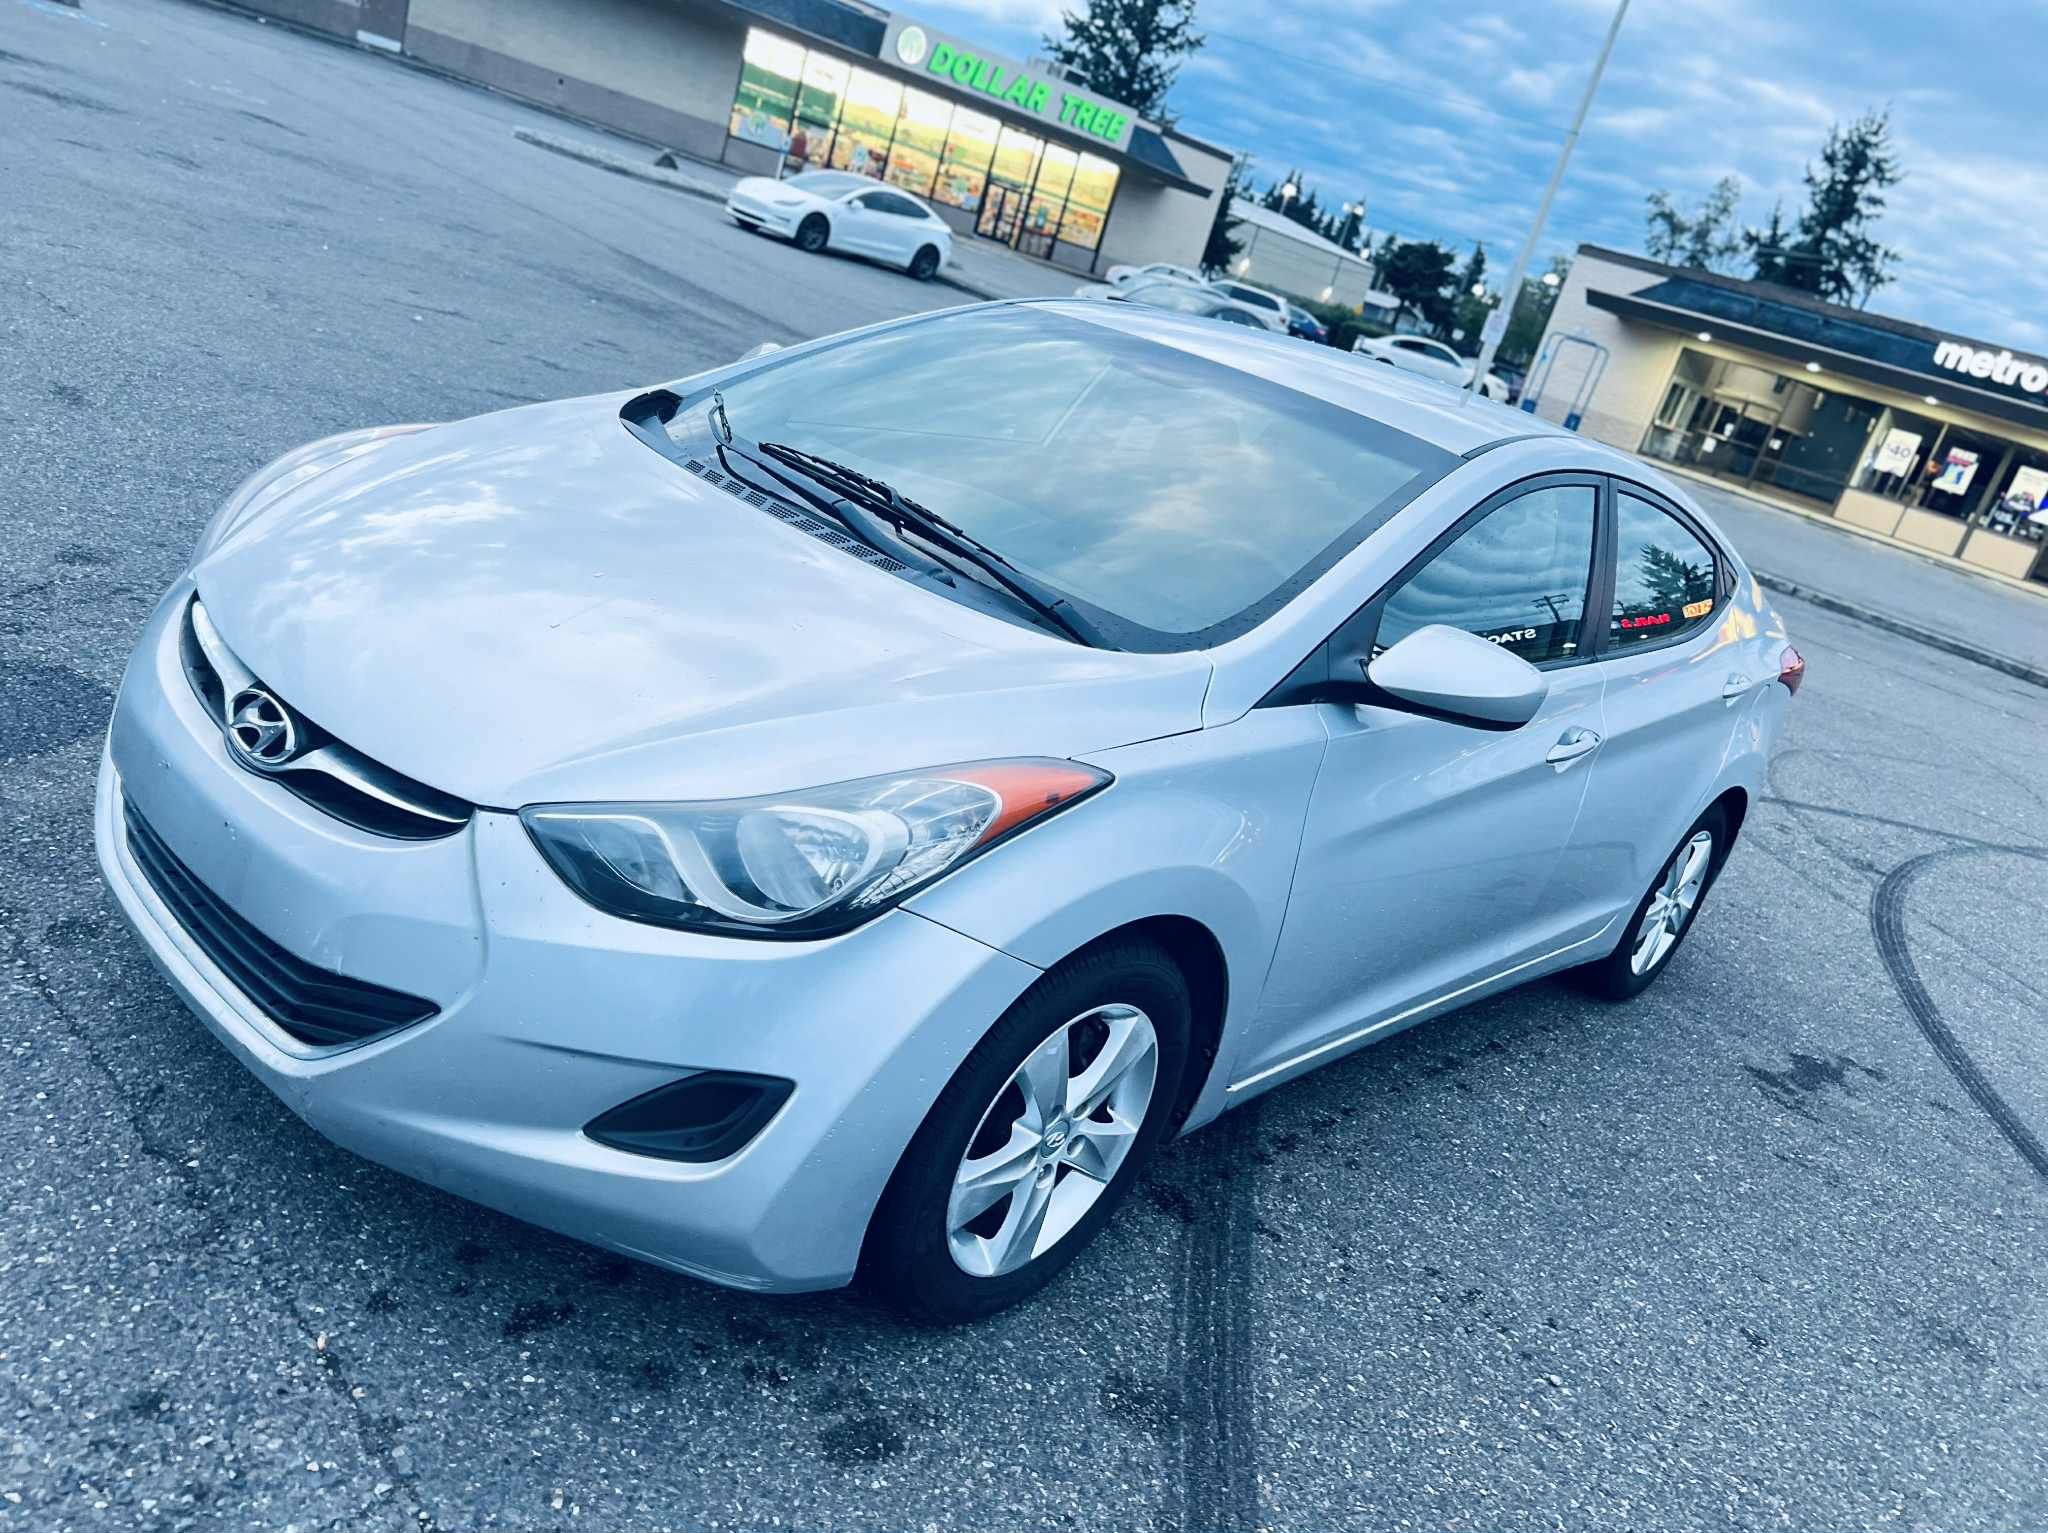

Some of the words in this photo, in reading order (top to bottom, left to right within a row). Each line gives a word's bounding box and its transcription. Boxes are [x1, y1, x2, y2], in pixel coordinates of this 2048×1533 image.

[927, 42, 1052, 113] DOLLAR
[1058, 91, 1128, 143] TREE
[1933, 340, 2048, 393] metro
